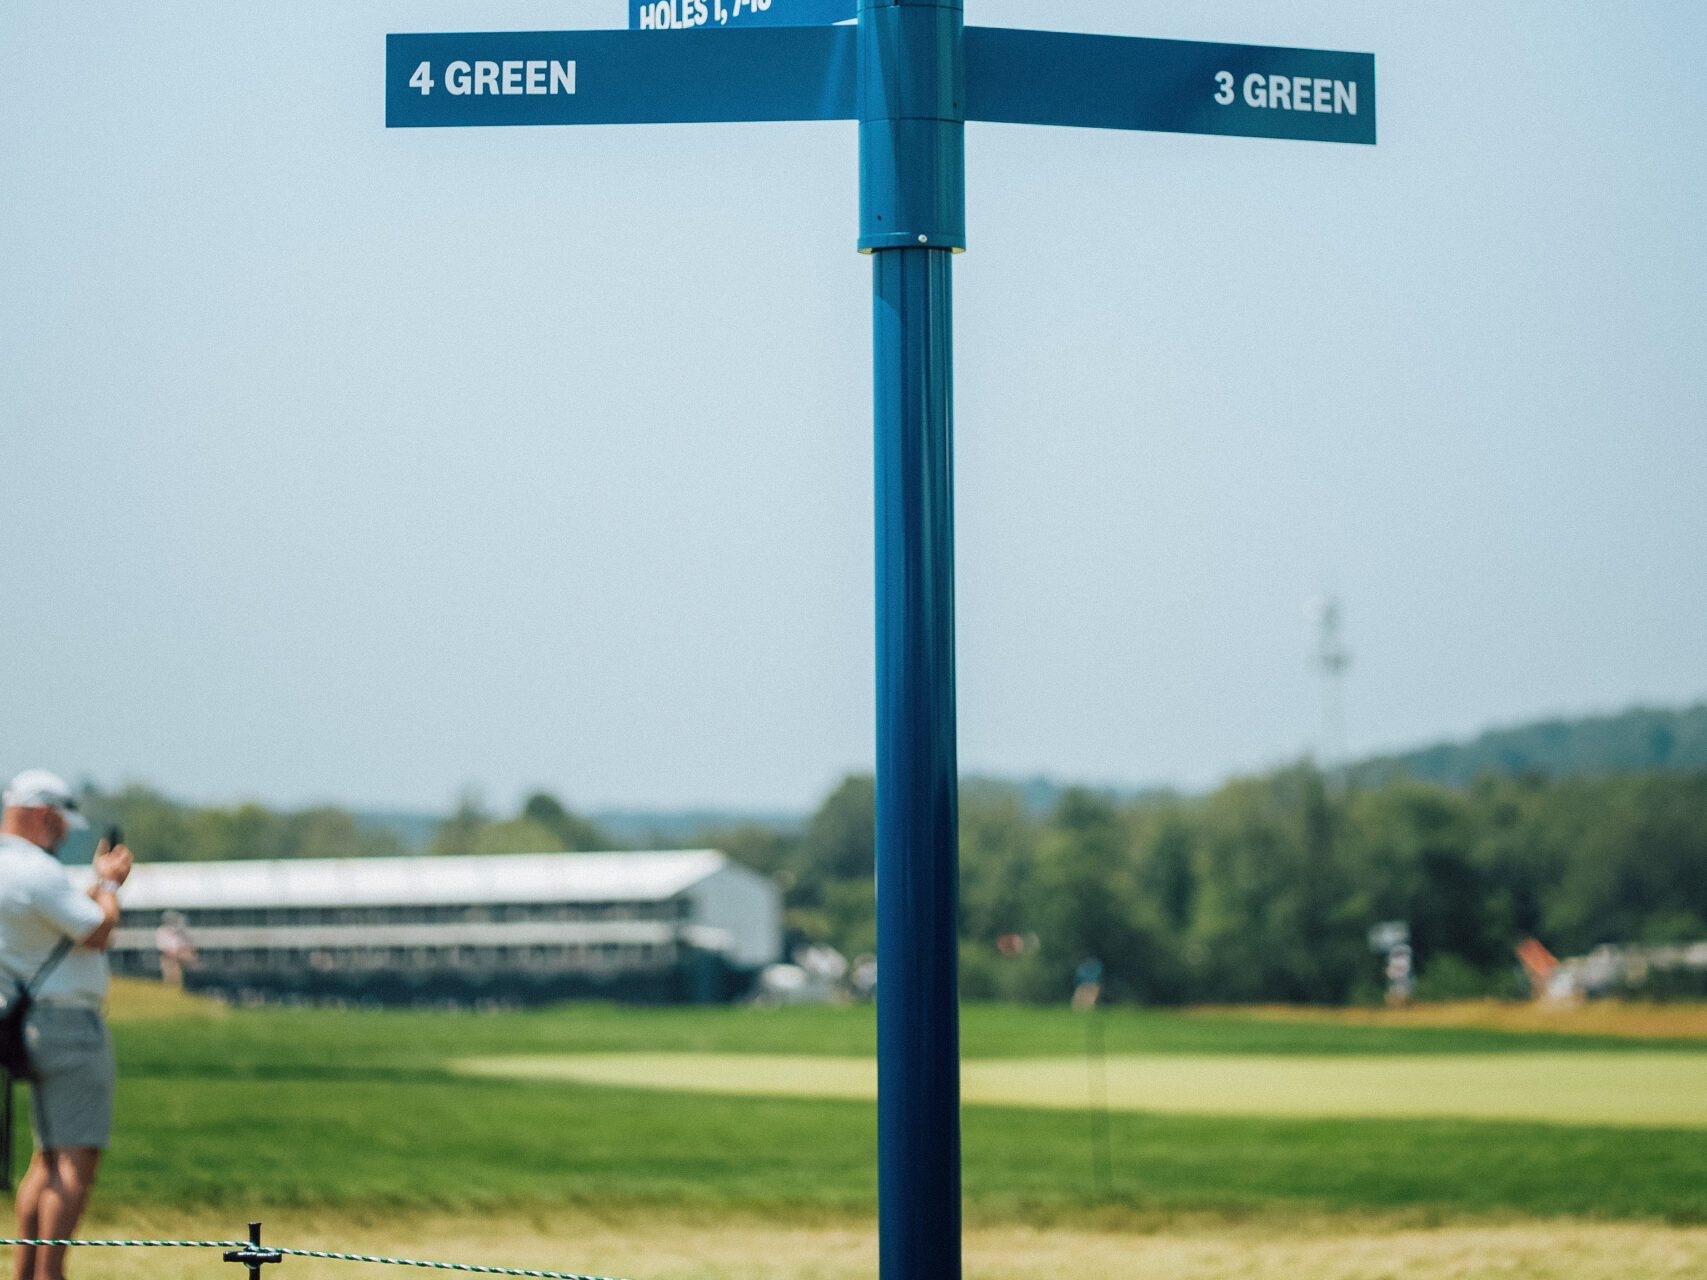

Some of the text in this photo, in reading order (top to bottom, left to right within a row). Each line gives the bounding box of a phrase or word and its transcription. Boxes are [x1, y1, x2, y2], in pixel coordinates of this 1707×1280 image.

[409, 60, 577, 95] 4 GREEN
[1214, 71, 1357, 115] 3 GREEN
